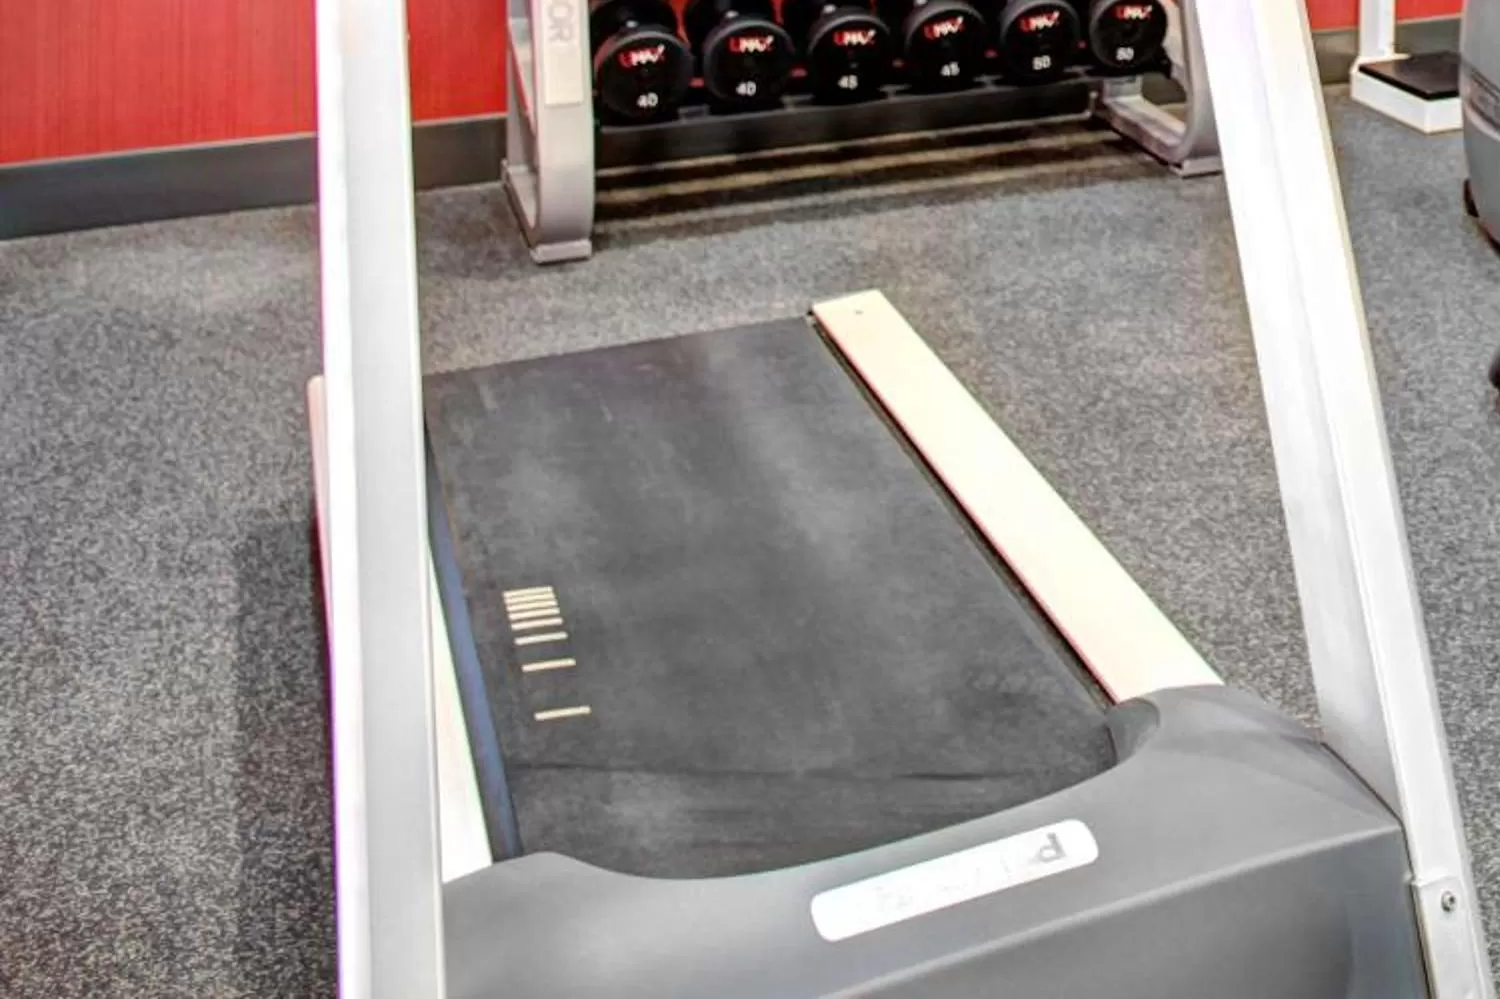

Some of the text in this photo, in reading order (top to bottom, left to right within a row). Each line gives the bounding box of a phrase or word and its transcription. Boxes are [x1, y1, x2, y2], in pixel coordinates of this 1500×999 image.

[940, 60, 960, 77] 45
[735, 80, 757, 97] 40
[837, 74, 859, 90] 45
[636, 91, 659, 109] 40
